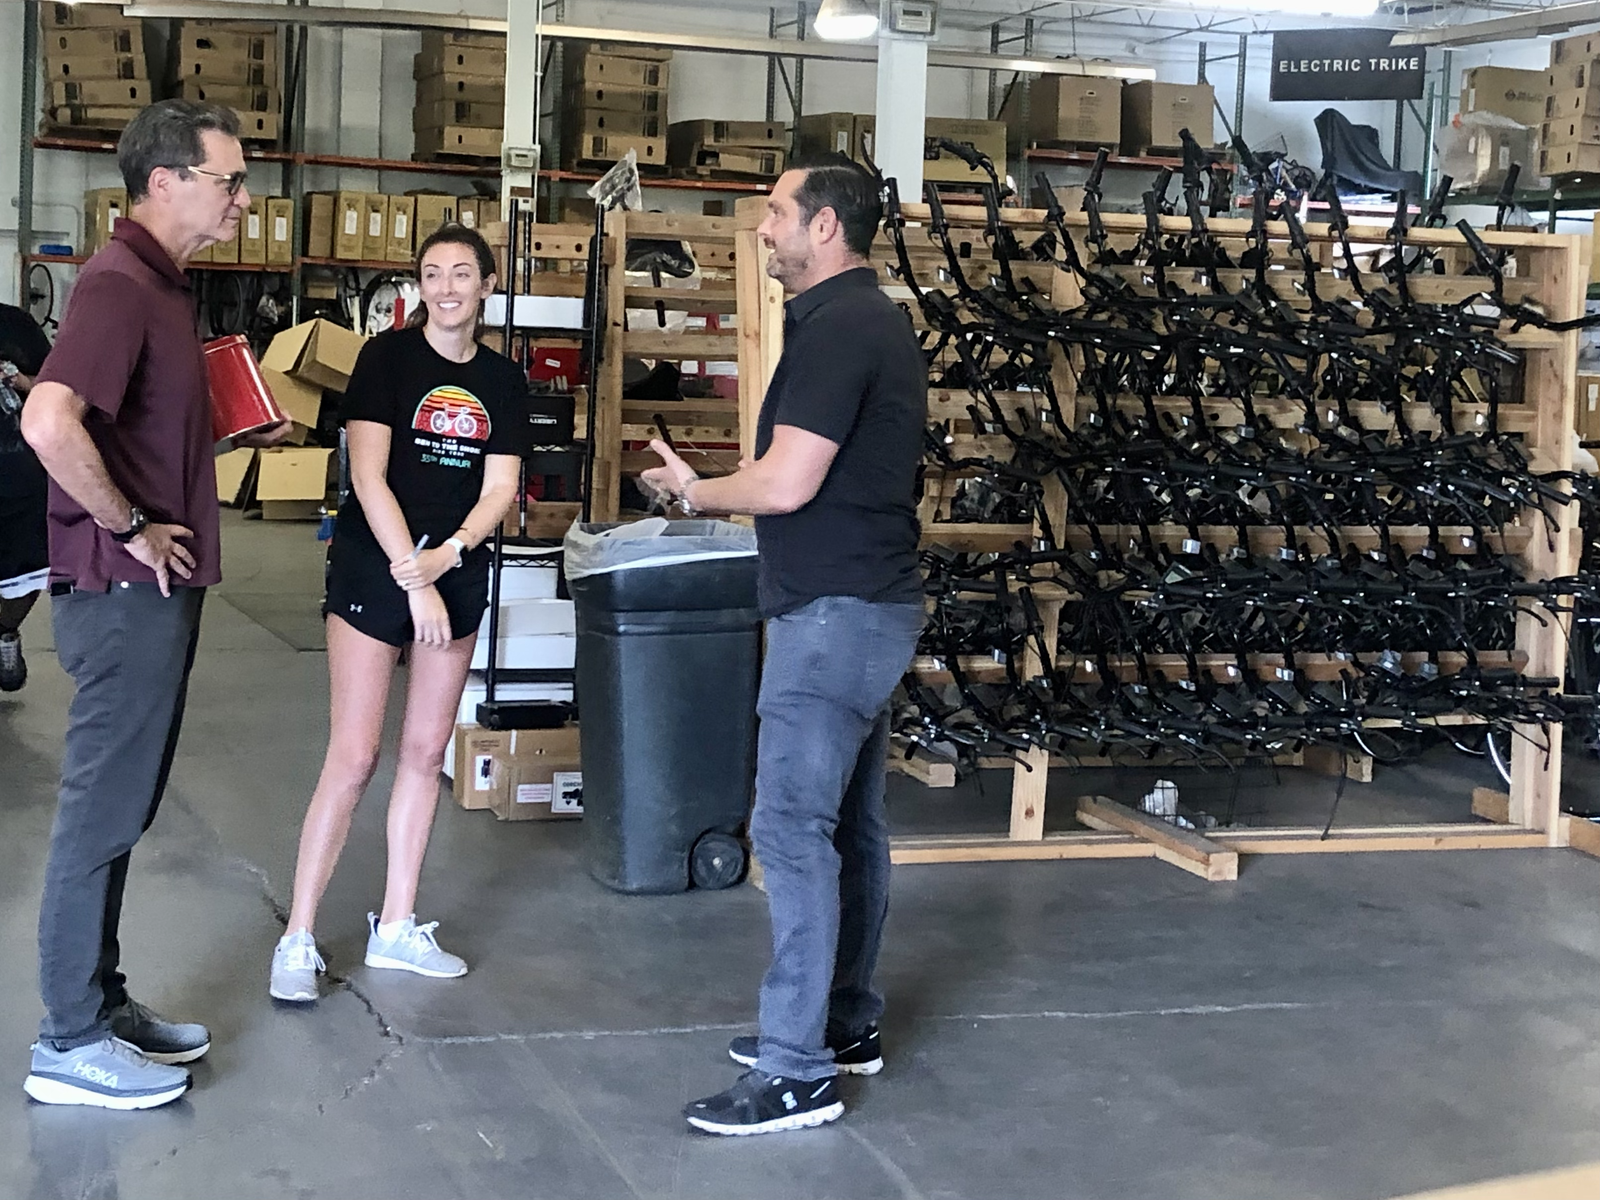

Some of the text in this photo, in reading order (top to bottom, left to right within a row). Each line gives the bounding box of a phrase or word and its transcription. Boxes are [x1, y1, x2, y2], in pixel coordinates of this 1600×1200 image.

[1279, 57, 1419, 72] ELECTRIC TRIKE
[73, 1060, 118, 1089] HOKA
